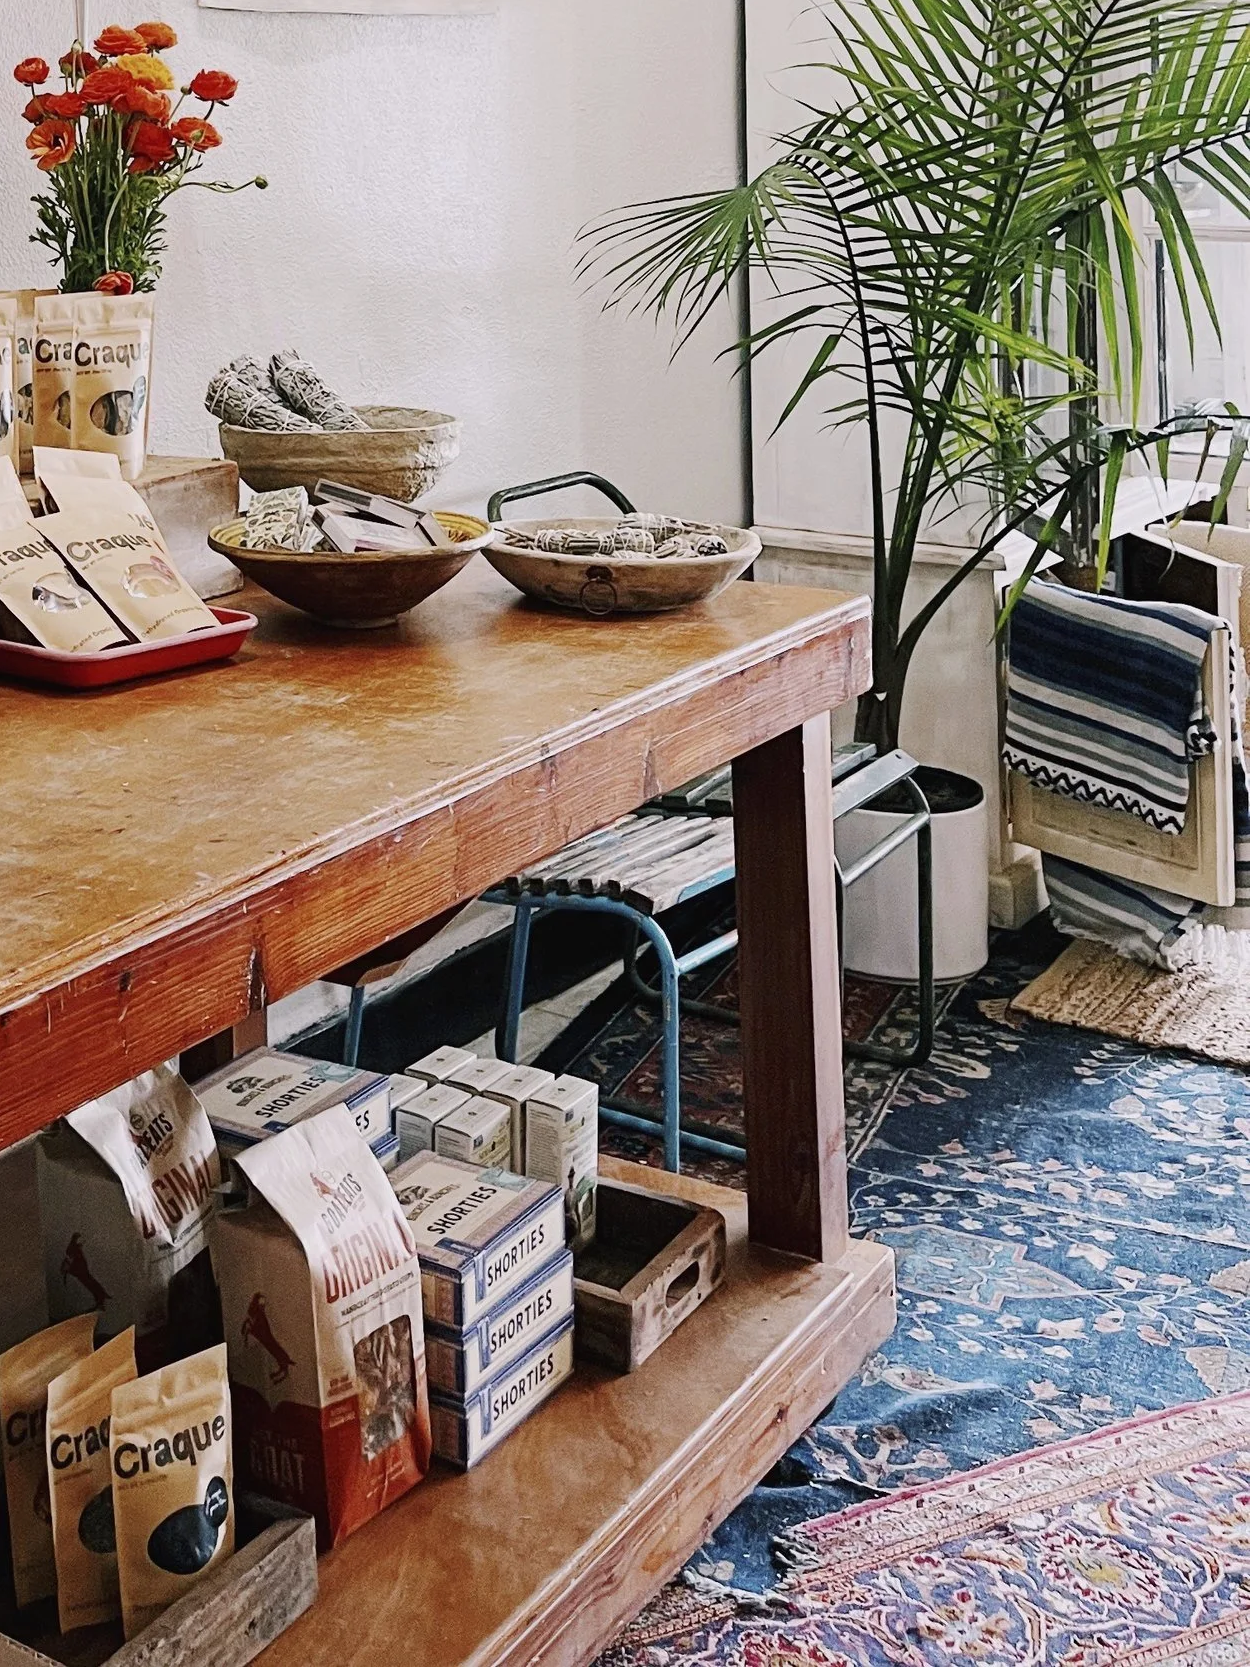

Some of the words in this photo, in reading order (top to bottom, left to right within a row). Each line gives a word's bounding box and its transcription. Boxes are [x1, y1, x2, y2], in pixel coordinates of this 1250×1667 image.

[34, 338, 72, 364] Cra
[74, 341, 150, 369] Craque
[66, 534, 153, 563] Craque
[255, 1075, 327, 1119] SHORTIES
[427, 1185, 498, 1235] SHORTIES
[487, 1224, 545, 1286] SHORTIES
[490, 1289, 552, 1355] SHORTIES
[493, 1353, 554, 1421] SHORTIES
[113, 1414, 226, 1480] Craque
